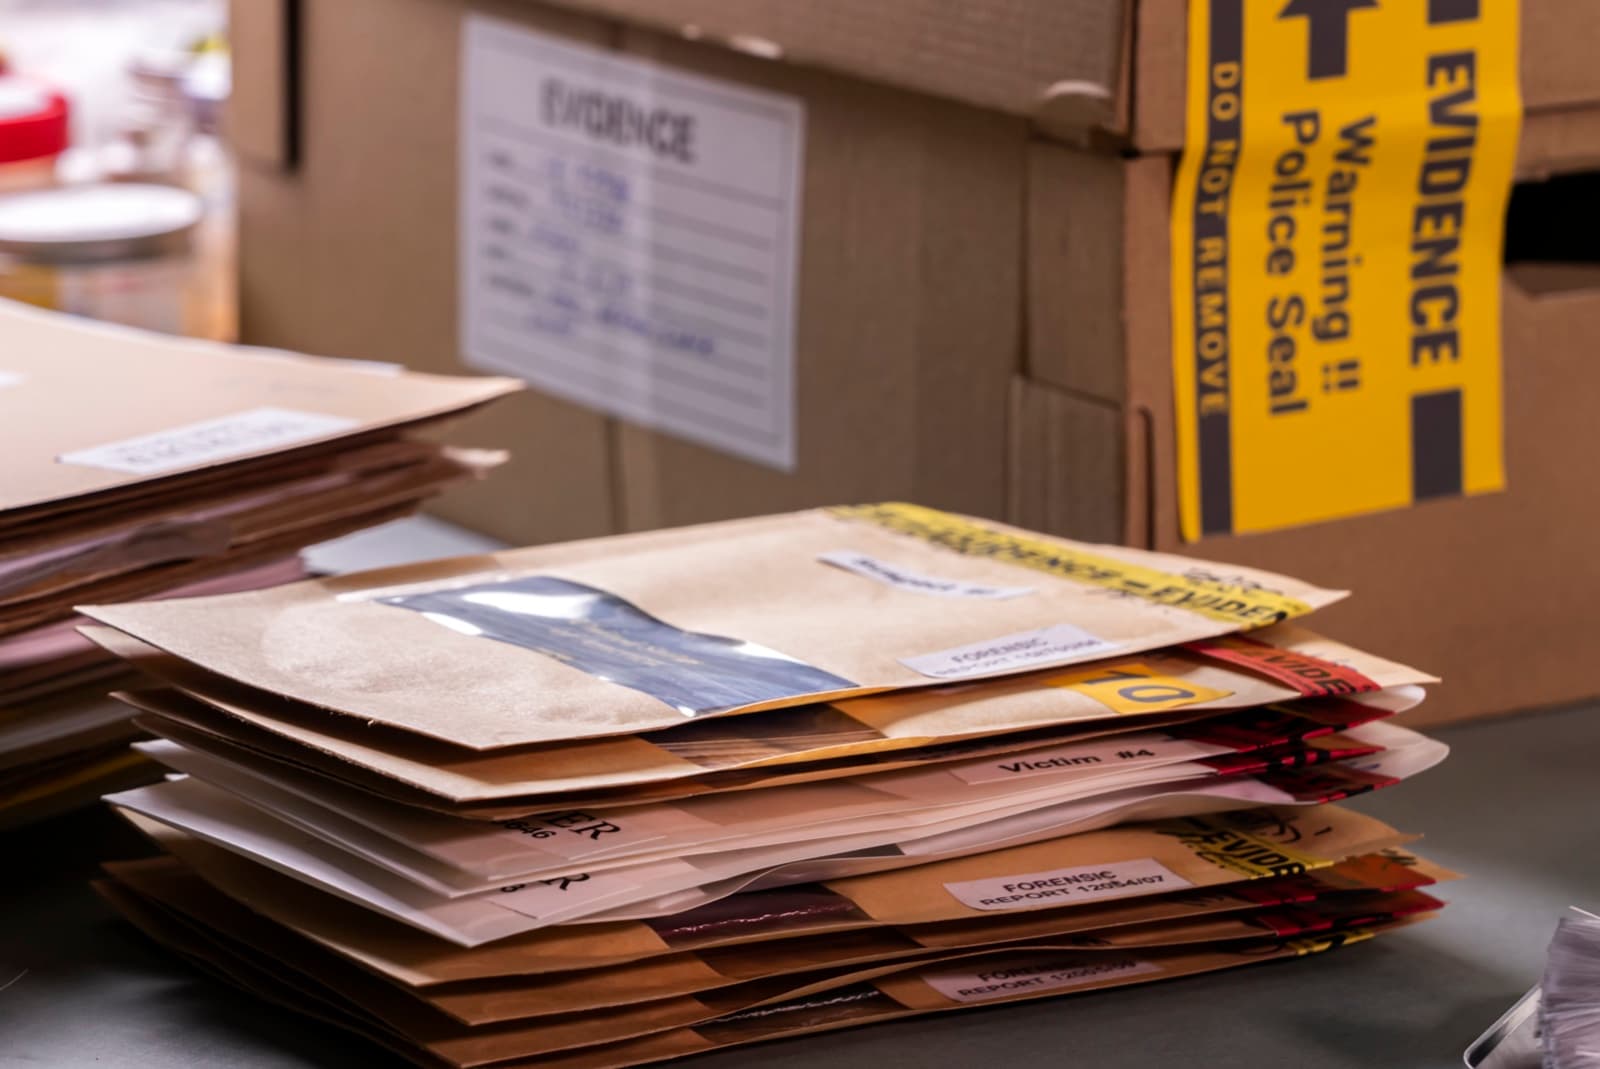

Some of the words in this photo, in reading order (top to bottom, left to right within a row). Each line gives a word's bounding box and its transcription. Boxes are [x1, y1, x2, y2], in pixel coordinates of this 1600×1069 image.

[540, 78, 695, 163] EVIDENCE
[1211, 61, 1240, 122] DO
[1199, 138, 1237, 217] NOT
[1266, 110, 1321, 278] Police
[1410, 50, 1479, 367] EVIDENCE
[1311, 113, 1377, 343] Warning
[1196, 236, 1228, 416] REMOVE
[1266, 293, 1308, 418] Seal
[998, 754, 1103, 774] Victim
[535, 811, 621, 840] ER
[979, 888, 1071, 906] REPORT
[1002, 869, 1118, 894] FORENSIC
[957, 976, 1046, 997] REPORT
